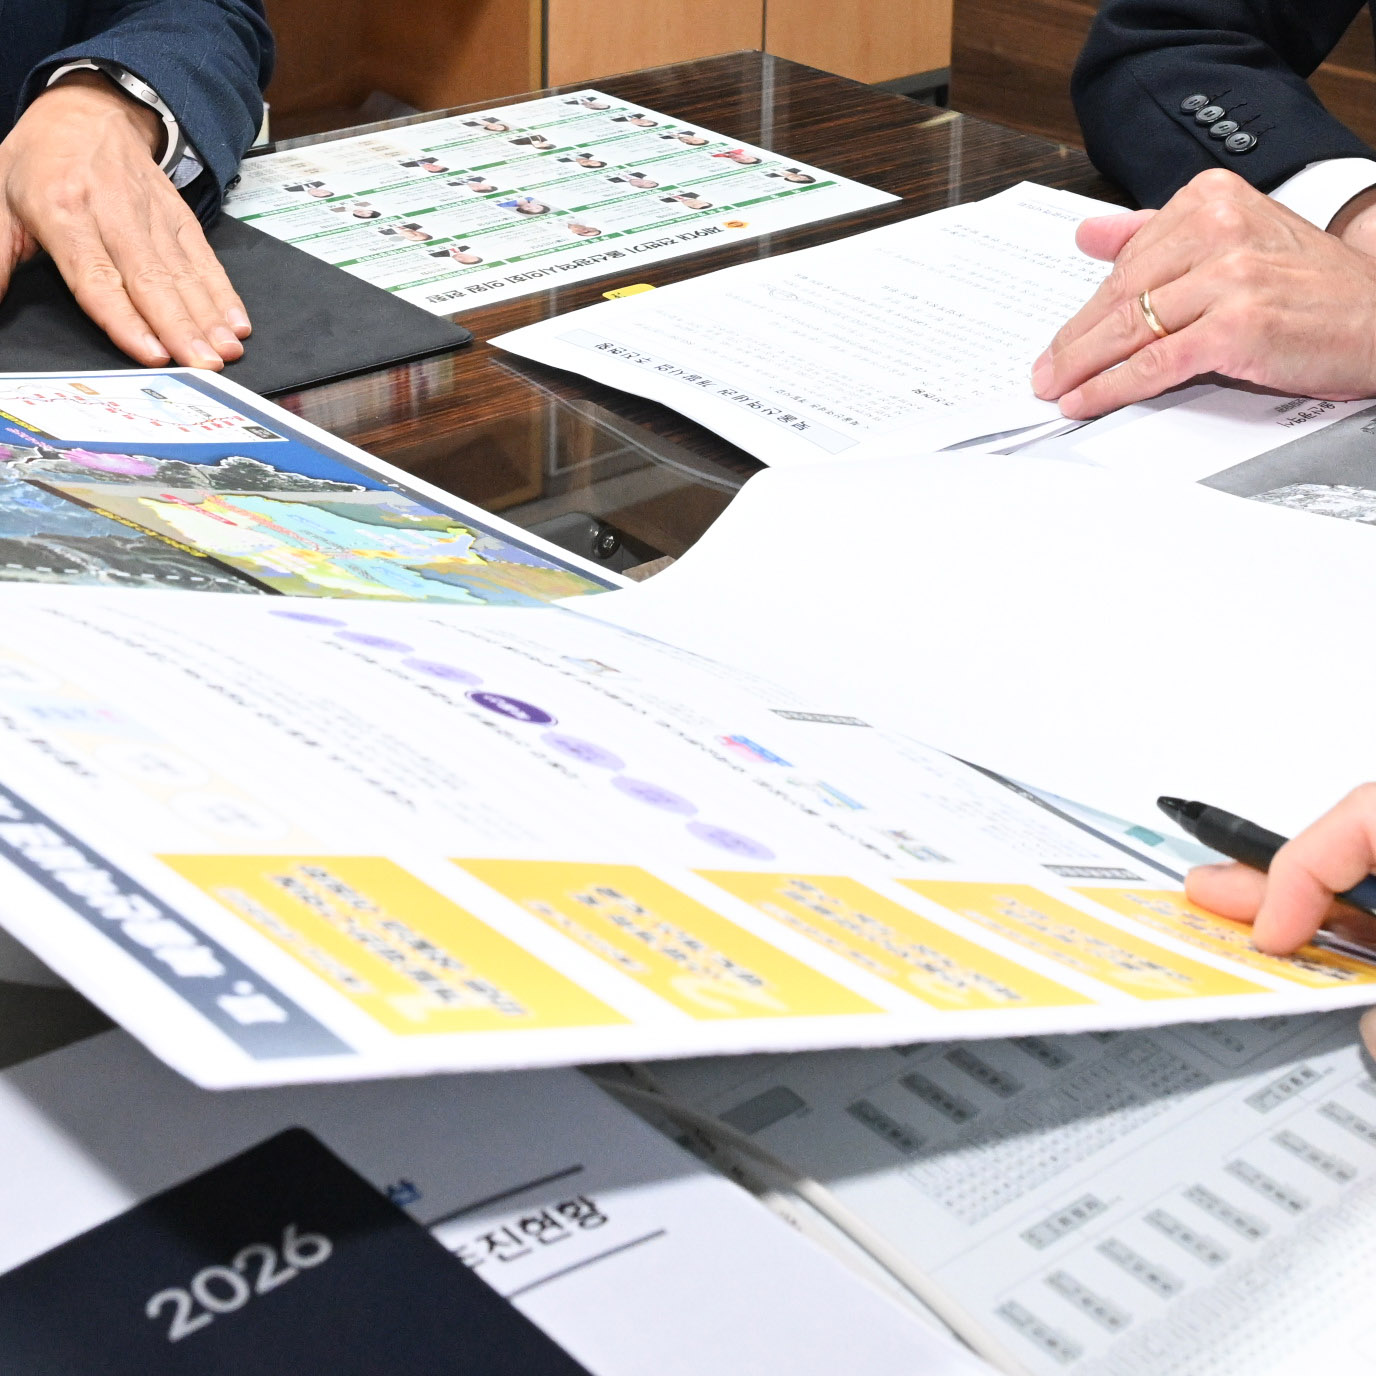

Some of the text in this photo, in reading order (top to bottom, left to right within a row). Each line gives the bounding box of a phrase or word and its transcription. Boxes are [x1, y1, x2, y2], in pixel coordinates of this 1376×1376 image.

[424, 224, 724, 304] 제9대 전반기 울산광역시의회 의원 현황
[593, 340, 811, 432] 북울산역세권 개발사업 추진현황
[146, 1223, 334, 1343] 2026
